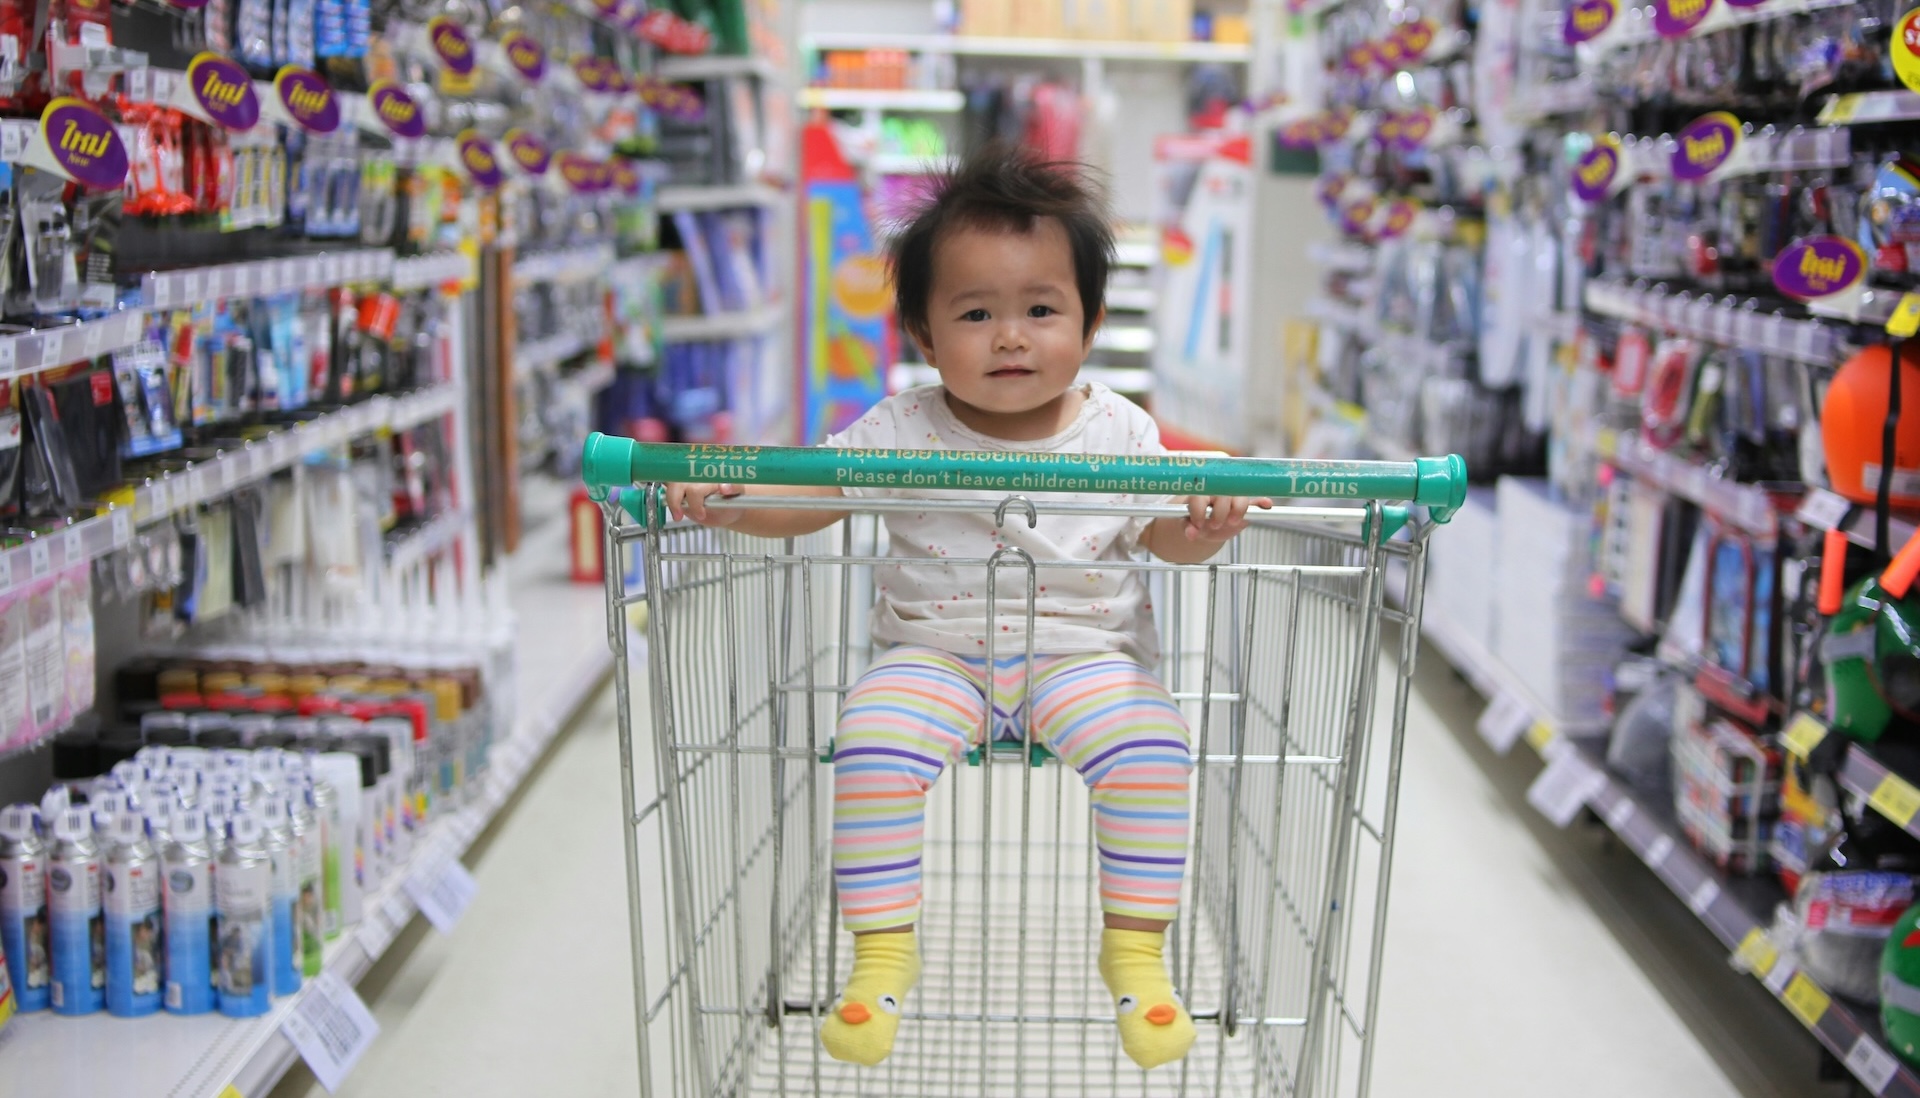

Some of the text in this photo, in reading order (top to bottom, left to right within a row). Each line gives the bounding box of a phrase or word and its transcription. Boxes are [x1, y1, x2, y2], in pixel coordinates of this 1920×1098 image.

[60, 119, 112, 158] ใหม่
[688, 460, 758, 479] Lotus
[836, 468, 1206, 492] Please don't leave children unattended
[1288, 474, 1359, 495] Lotus
